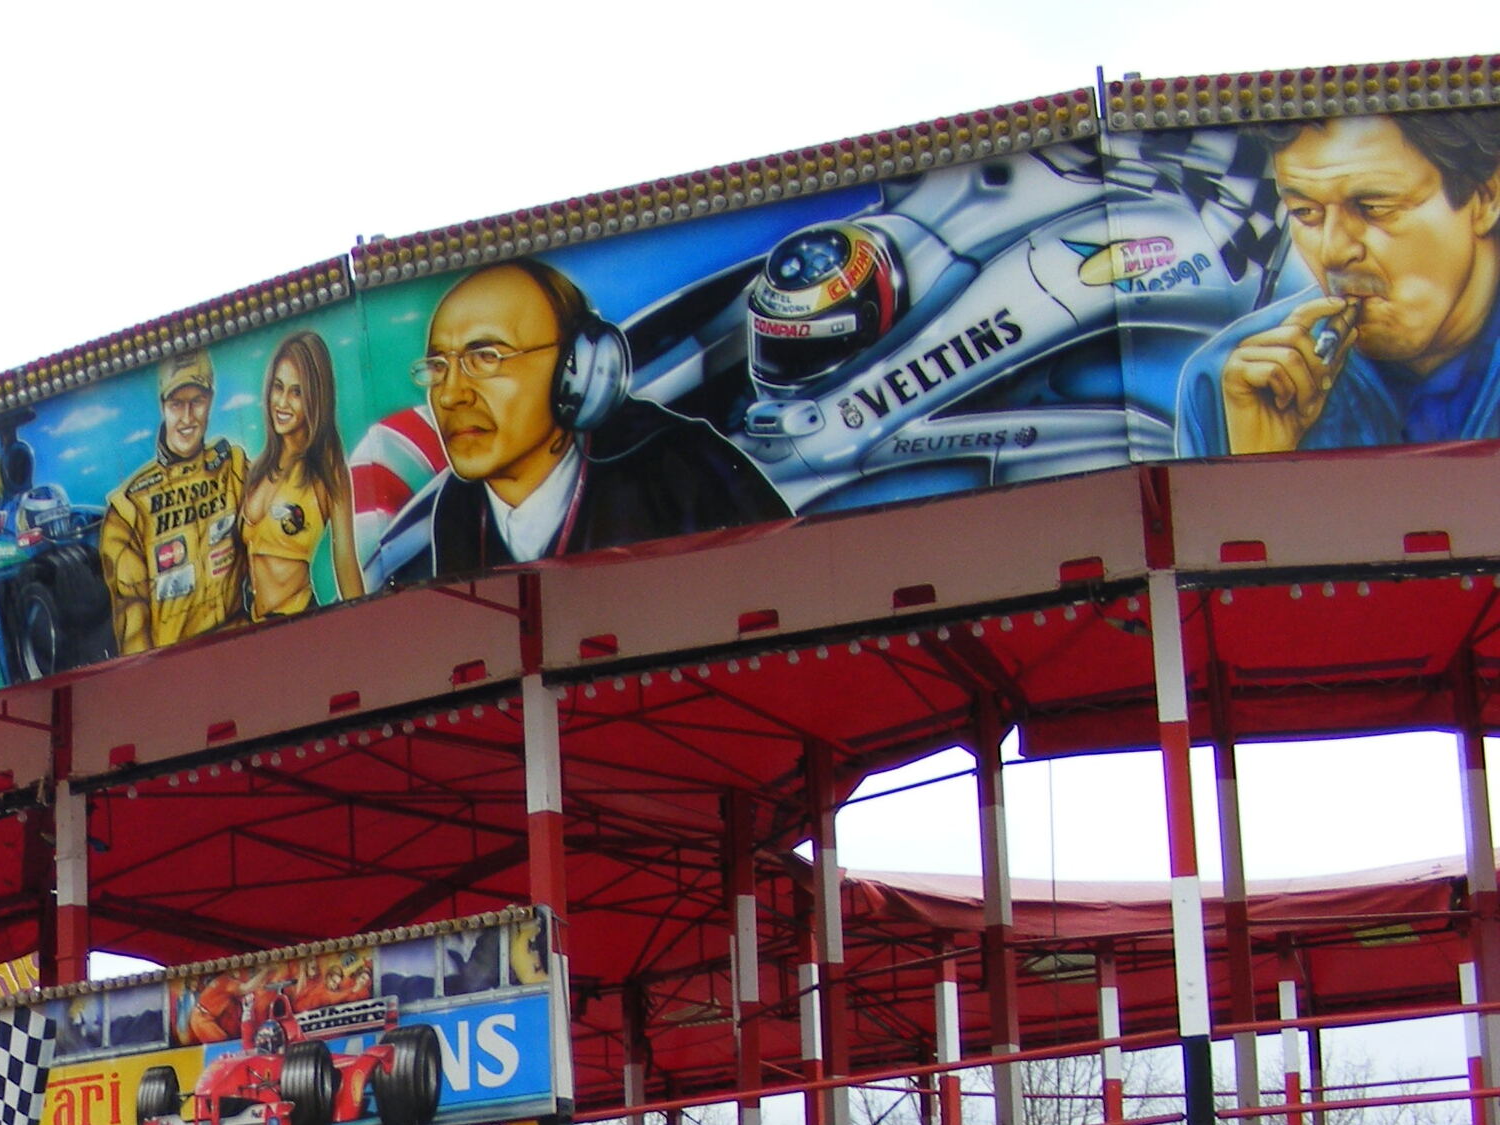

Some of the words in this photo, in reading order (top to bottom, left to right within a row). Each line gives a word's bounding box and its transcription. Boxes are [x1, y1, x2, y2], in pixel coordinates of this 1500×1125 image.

[854, 308, 1023, 418] VELTINS
[892, 430, 1008, 454] REUTERS
[150, 480, 219, 514] BENSON
[156, 494, 228, 536] HEDGES
